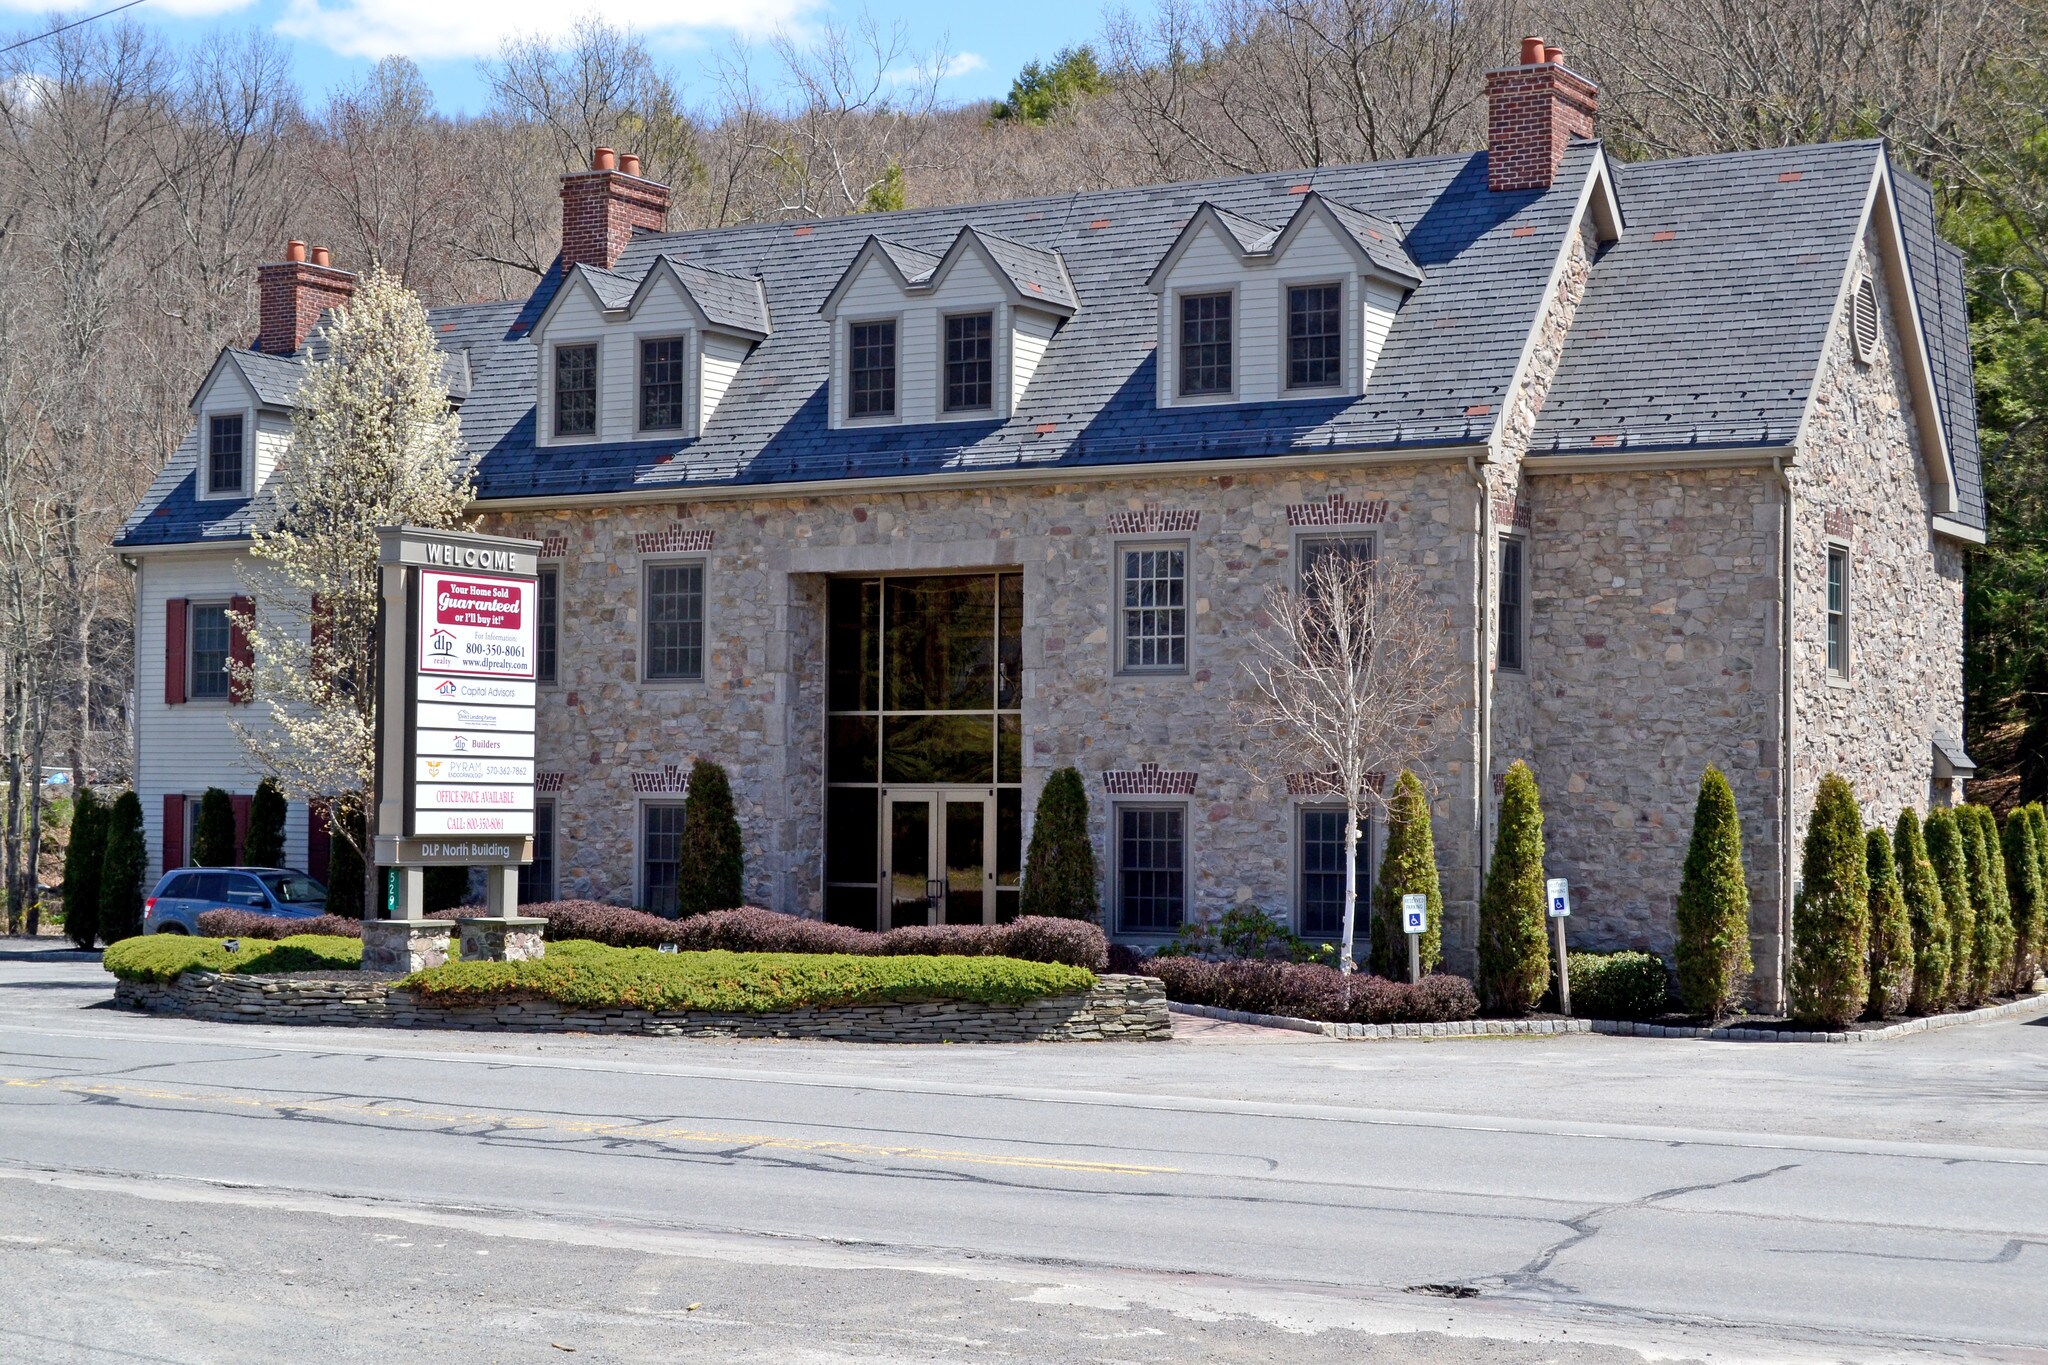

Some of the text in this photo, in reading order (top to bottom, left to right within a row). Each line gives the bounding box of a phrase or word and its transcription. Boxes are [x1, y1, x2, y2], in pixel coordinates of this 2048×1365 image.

[427, 544, 516, 569] WELCOME
[450, 584, 509, 598] Your Home Sold
[439, 593, 520, 613] Guaranteed
[465, 613, 476, 623] I'll
[477, 615, 491, 626] buy
[475, 632, 484, 640] For
[434, 635, 452, 654] dlp
[466, 643, 525, 657] 800-350-8061
[434, 657, 451, 667] realty
[462, 658, 528, 671] www.dlprealty.com
[461, 686, 486, 697] Capital
[488, 686, 515, 697] Advisors
[455, 739, 500, 749] dlp Builders
[450, 761, 482, 772] PYRAM
[486, 766, 527, 776] 570-362-7862
[436, 790, 515, 804] OFFICE SPACE AVAILABLE
[447, 817, 504, 830] CALL: 800-350-8061
[421, 843, 510, 858] DLP North Building
